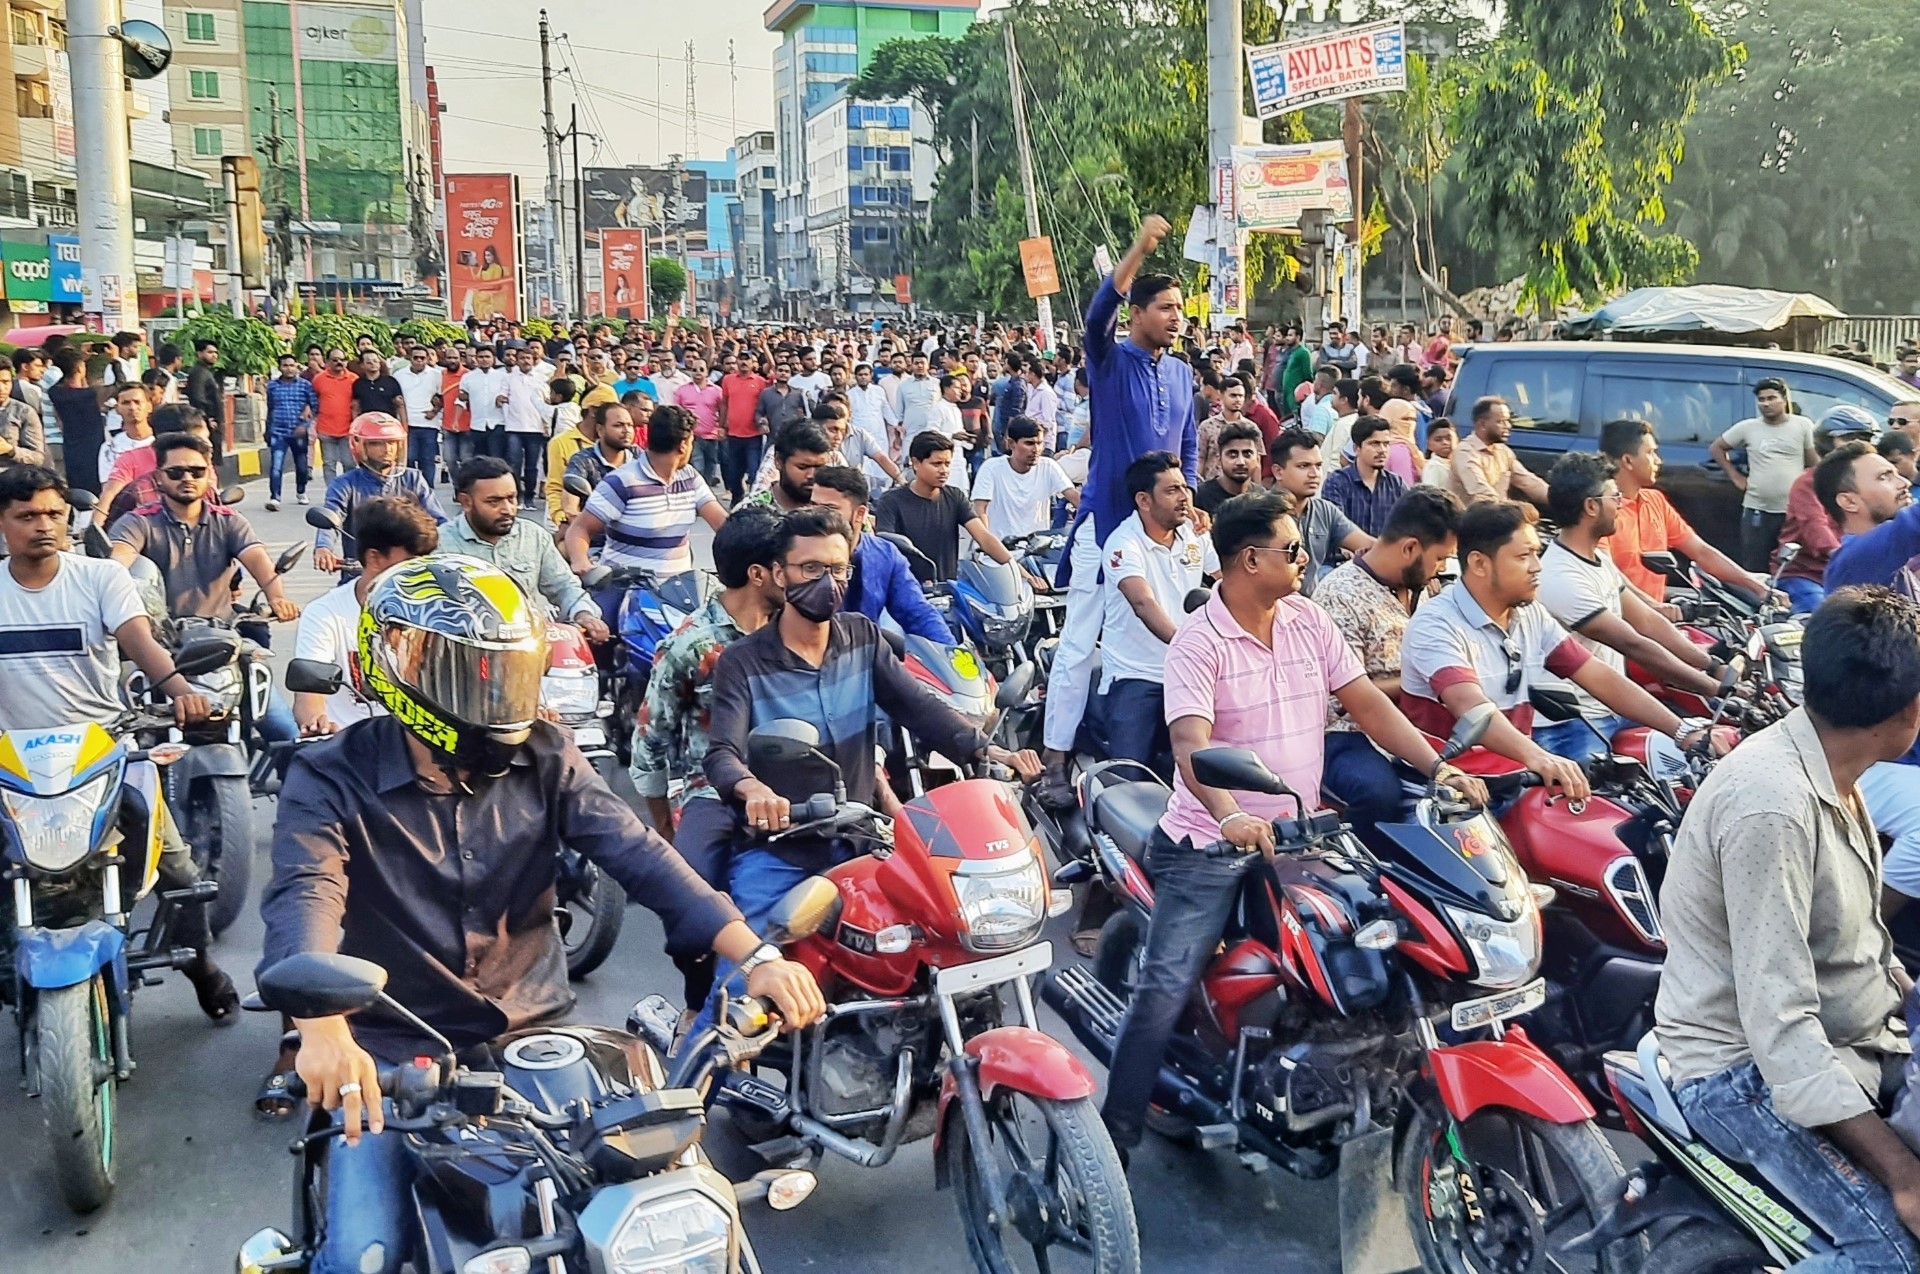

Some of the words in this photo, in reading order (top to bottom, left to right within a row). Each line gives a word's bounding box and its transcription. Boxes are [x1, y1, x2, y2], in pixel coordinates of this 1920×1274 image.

[306, 25, 347, 43] ajker
[1288, 37, 1373, 81] AVIJIT'S
[1291, 73, 1336, 93] SPECIAL
[1338, 67, 1372, 83] BATCH
[11, 260, 49, 281] oppo
[60, 274, 83, 293] viv
[23, 734, 81, 751] AKASH
[985, 839, 1010, 852] TVS
[1282, 909, 1302, 936] TVS
[845, 930, 875, 952] TVS
[1255, 1102, 1274, 1122] TVS
[1457, 1173, 1485, 1221] TVS
[1700, 1154, 1795, 1225] metro
